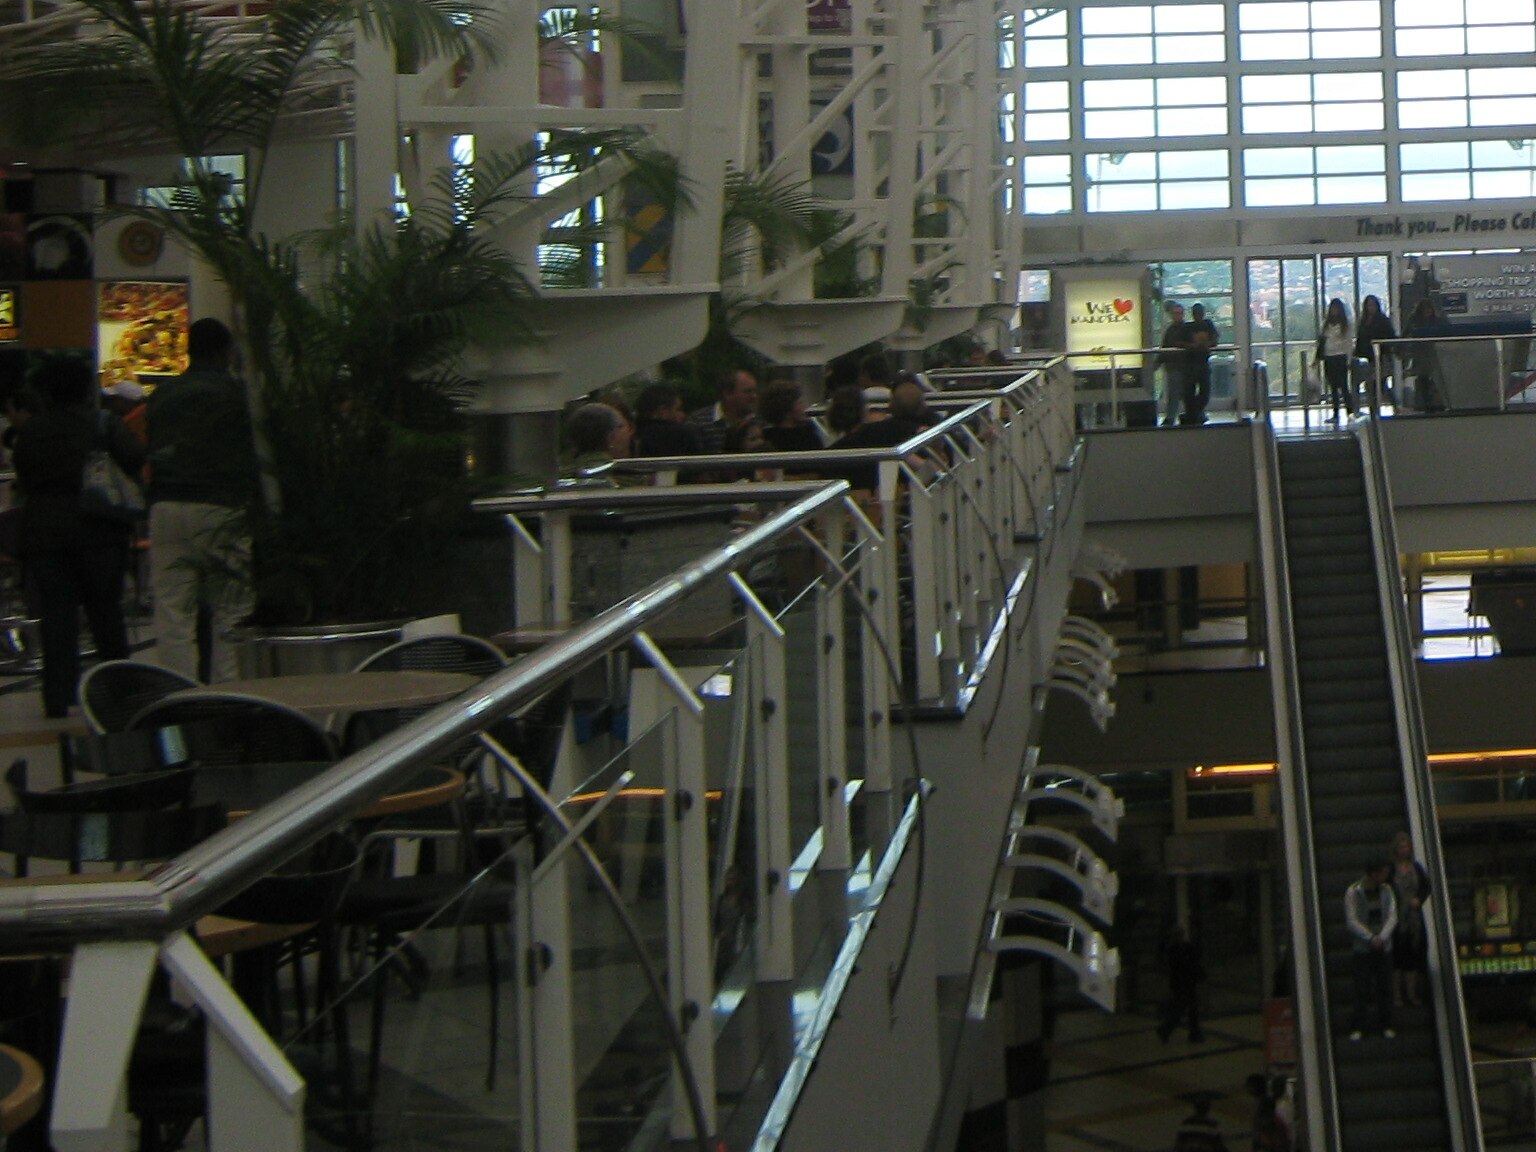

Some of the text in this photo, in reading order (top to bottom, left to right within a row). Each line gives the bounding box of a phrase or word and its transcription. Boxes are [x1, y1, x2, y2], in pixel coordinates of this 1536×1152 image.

[1356, 216, 1402, 236] Thank
[1453, 214, 1507, 232] Please
[1502, 263, 1536, 274] WIN A
[1447, 276, 1504, 290] SHOPPING
[1508, 275, 1533, 287] TRIP
[1474, 289, 1515, 300] WORTH
